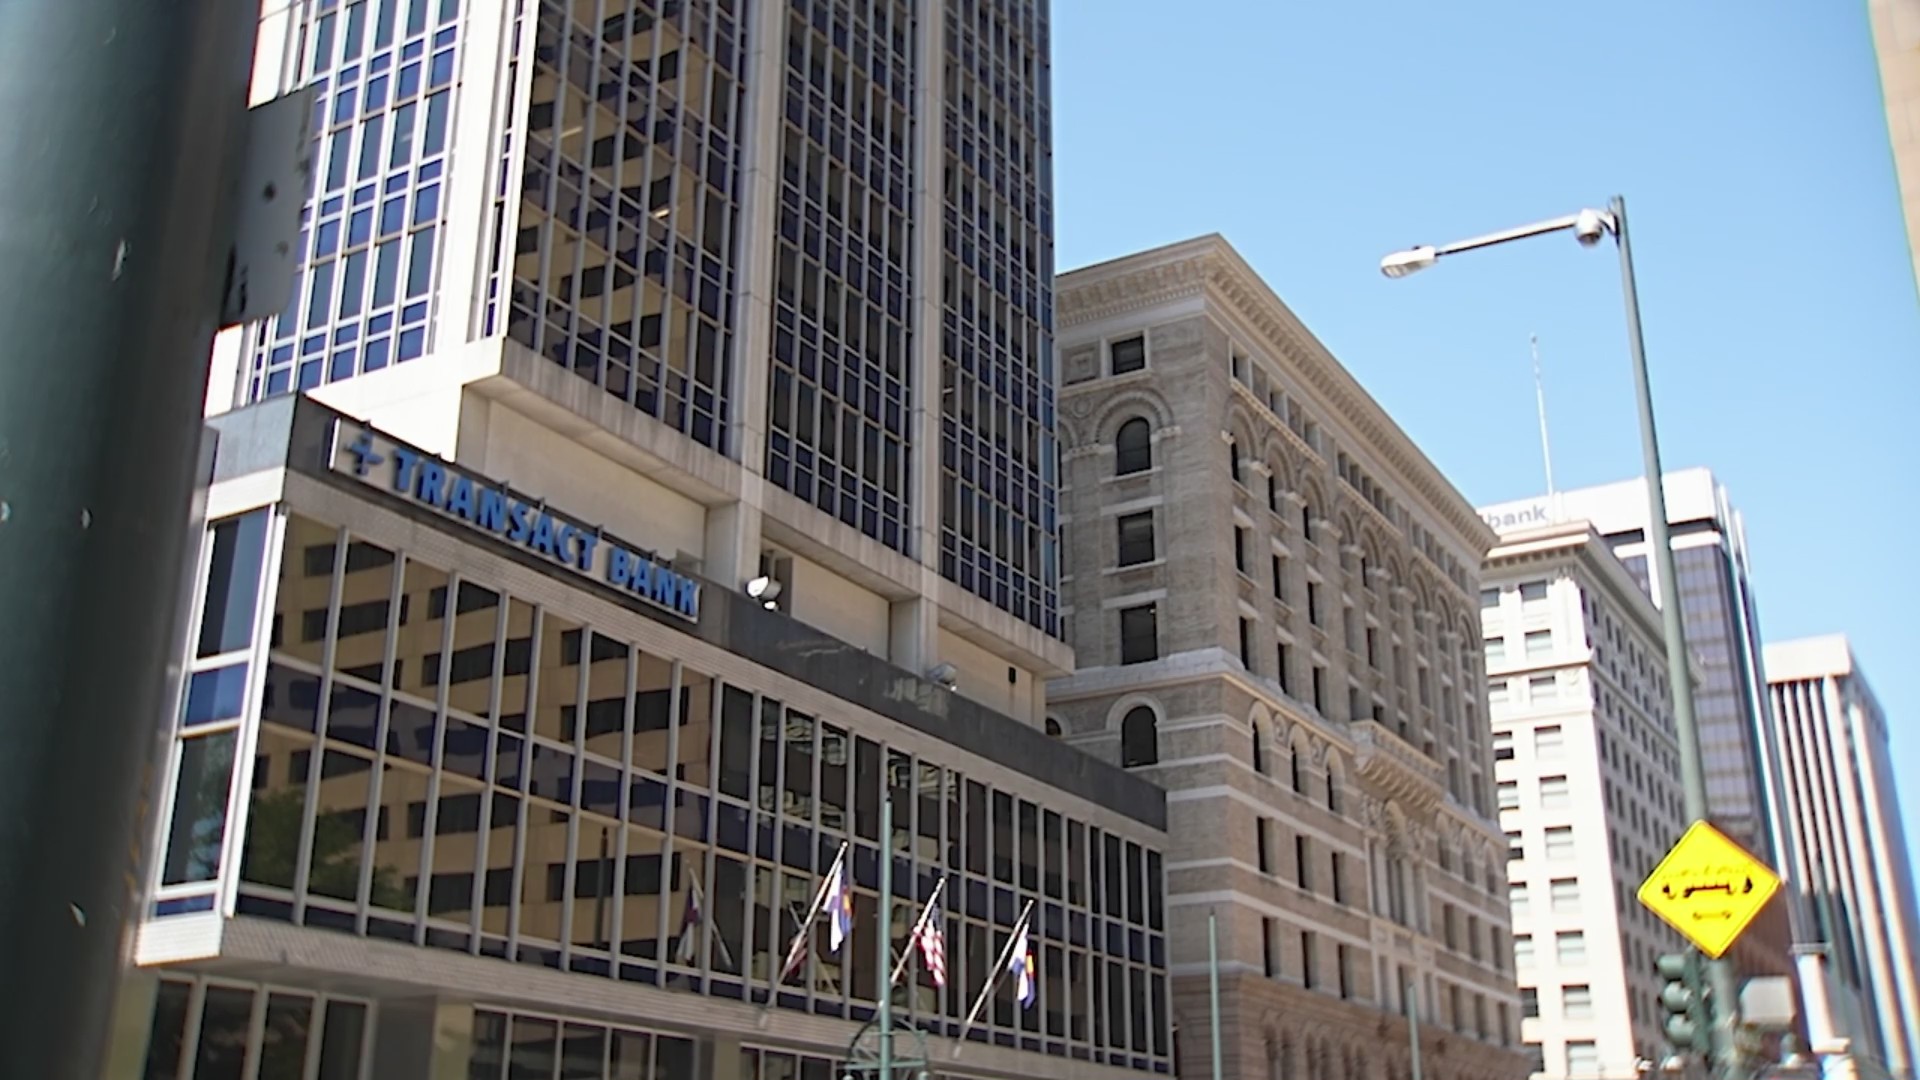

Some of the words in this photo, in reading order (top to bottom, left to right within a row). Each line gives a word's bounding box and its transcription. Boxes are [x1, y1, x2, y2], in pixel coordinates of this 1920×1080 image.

[392, 448, 599, 571] TRANSACT
[609, 546, 699, 616] BANK
[1488, 504, 1547, 529] bank
